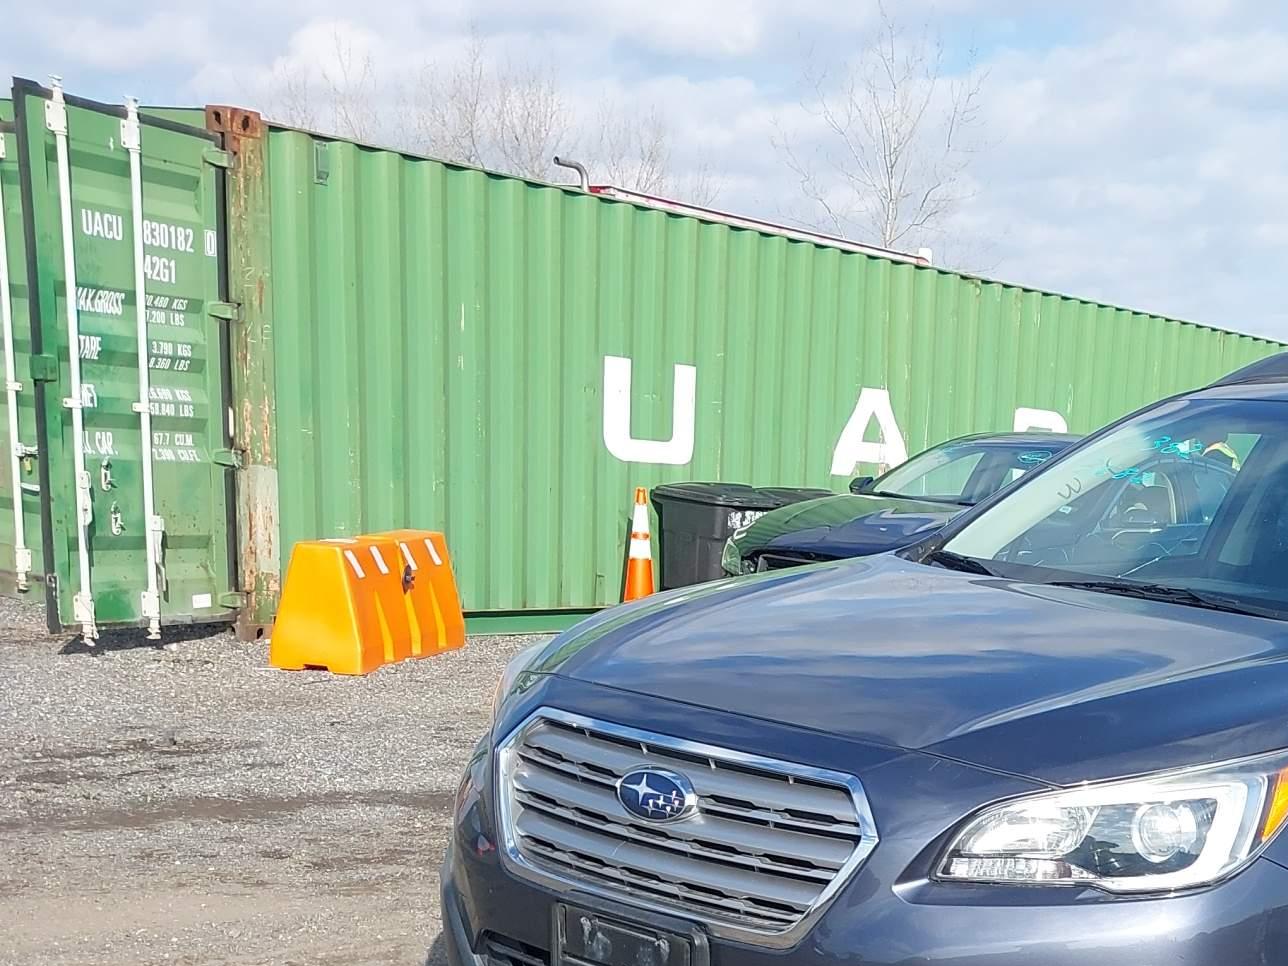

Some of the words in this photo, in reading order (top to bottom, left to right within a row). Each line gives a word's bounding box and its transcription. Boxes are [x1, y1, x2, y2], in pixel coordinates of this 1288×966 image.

[81, 208, 123, 241] UACU
[143, 219, 195, 253] 830182
[144, 254, 176, 284] 42G1
[172, 298, 189, 311] KGS
[145, 310, 166, 324] 7.200
[169, 312, 185, 327] LBS
[78, 335, 102, 360] TARE
[176, 343, 192, 357] KGS
[173, 359, 191, 371] LBS
[179, 404, 194, 418] LBS
